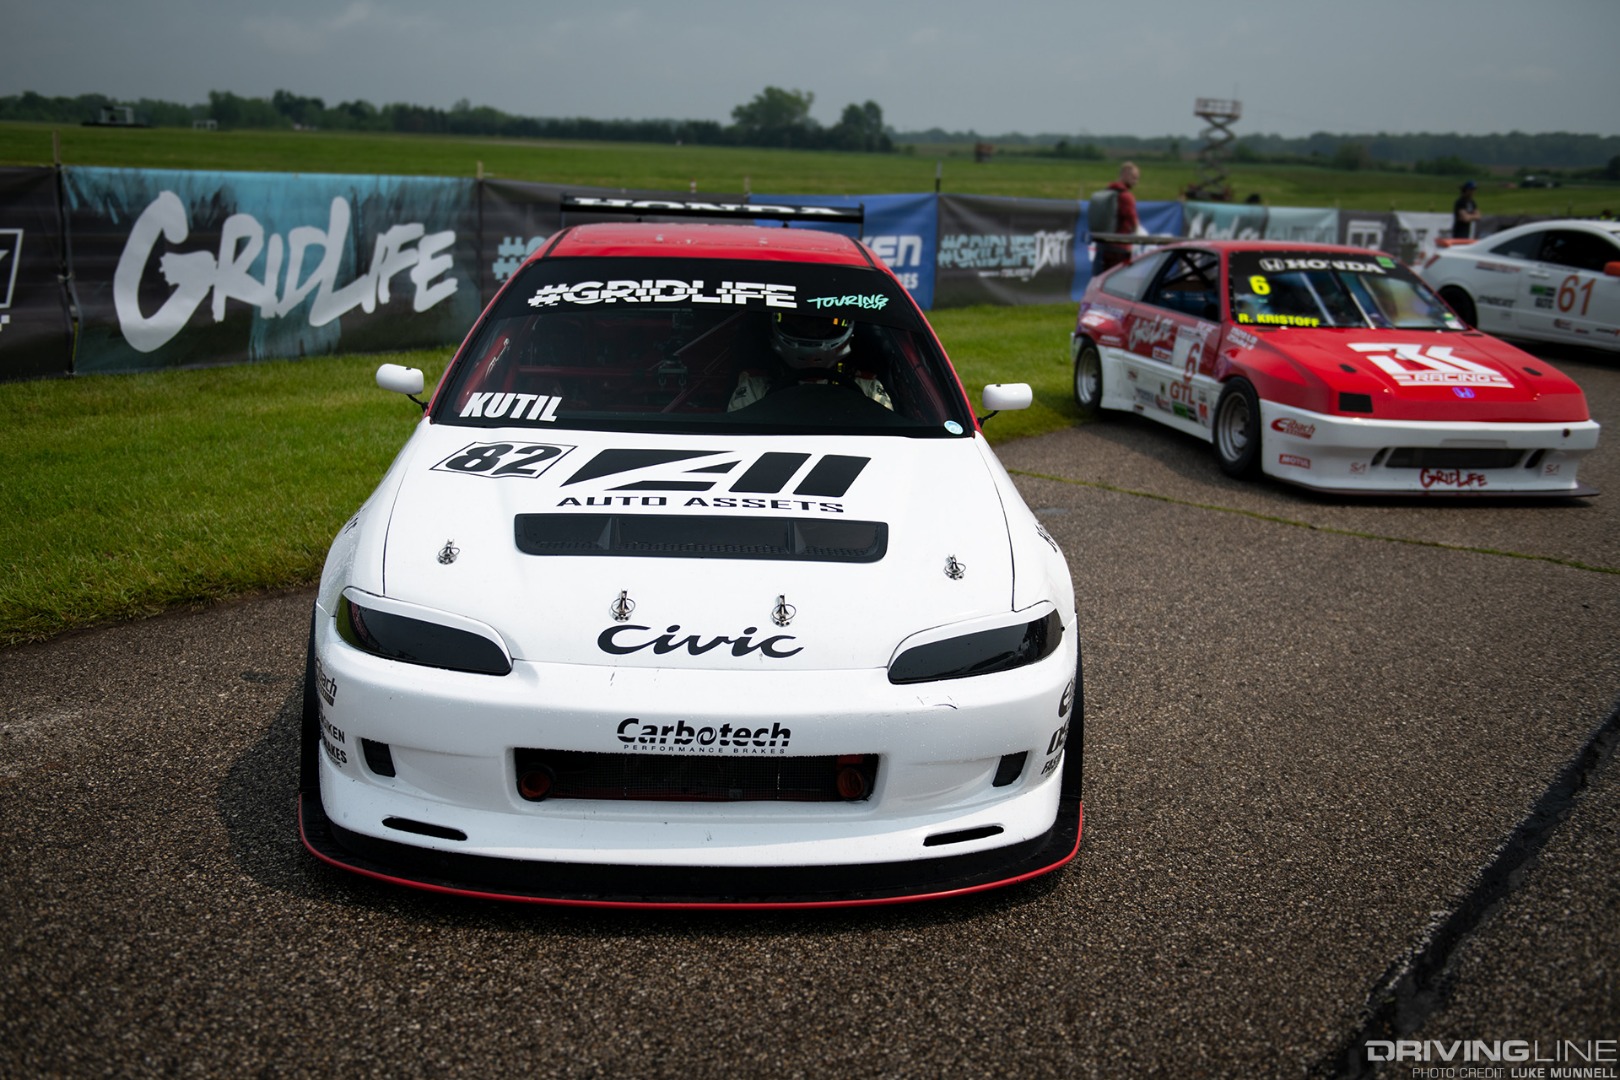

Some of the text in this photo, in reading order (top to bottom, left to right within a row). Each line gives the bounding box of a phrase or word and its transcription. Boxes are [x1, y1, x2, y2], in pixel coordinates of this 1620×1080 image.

[1284, 259, 1386, 274] HONDA
[528, 280, 797, 308] #GRIDLIFE
[1249, 275, 1271, 295] 6
[1558, 274, 1596, 316] 61
[807, 294, 889, 309] TOURING
[1238, 313, 1319, 328] R. KRISTOFF
[1415, 374, 1490, 383] RACING
[1169, 380, 1197, 406] GTL
[459, 392, 563, 422] KUTIL
[445, 444, 562, 475] 82
[556, 496, 845, 513] AUTO ASSETS
[597, 624, 804, 658] Civic
[616, 717, 791, 747] Carbotech
[623, 744, 724, 754] PERFORMANCE
